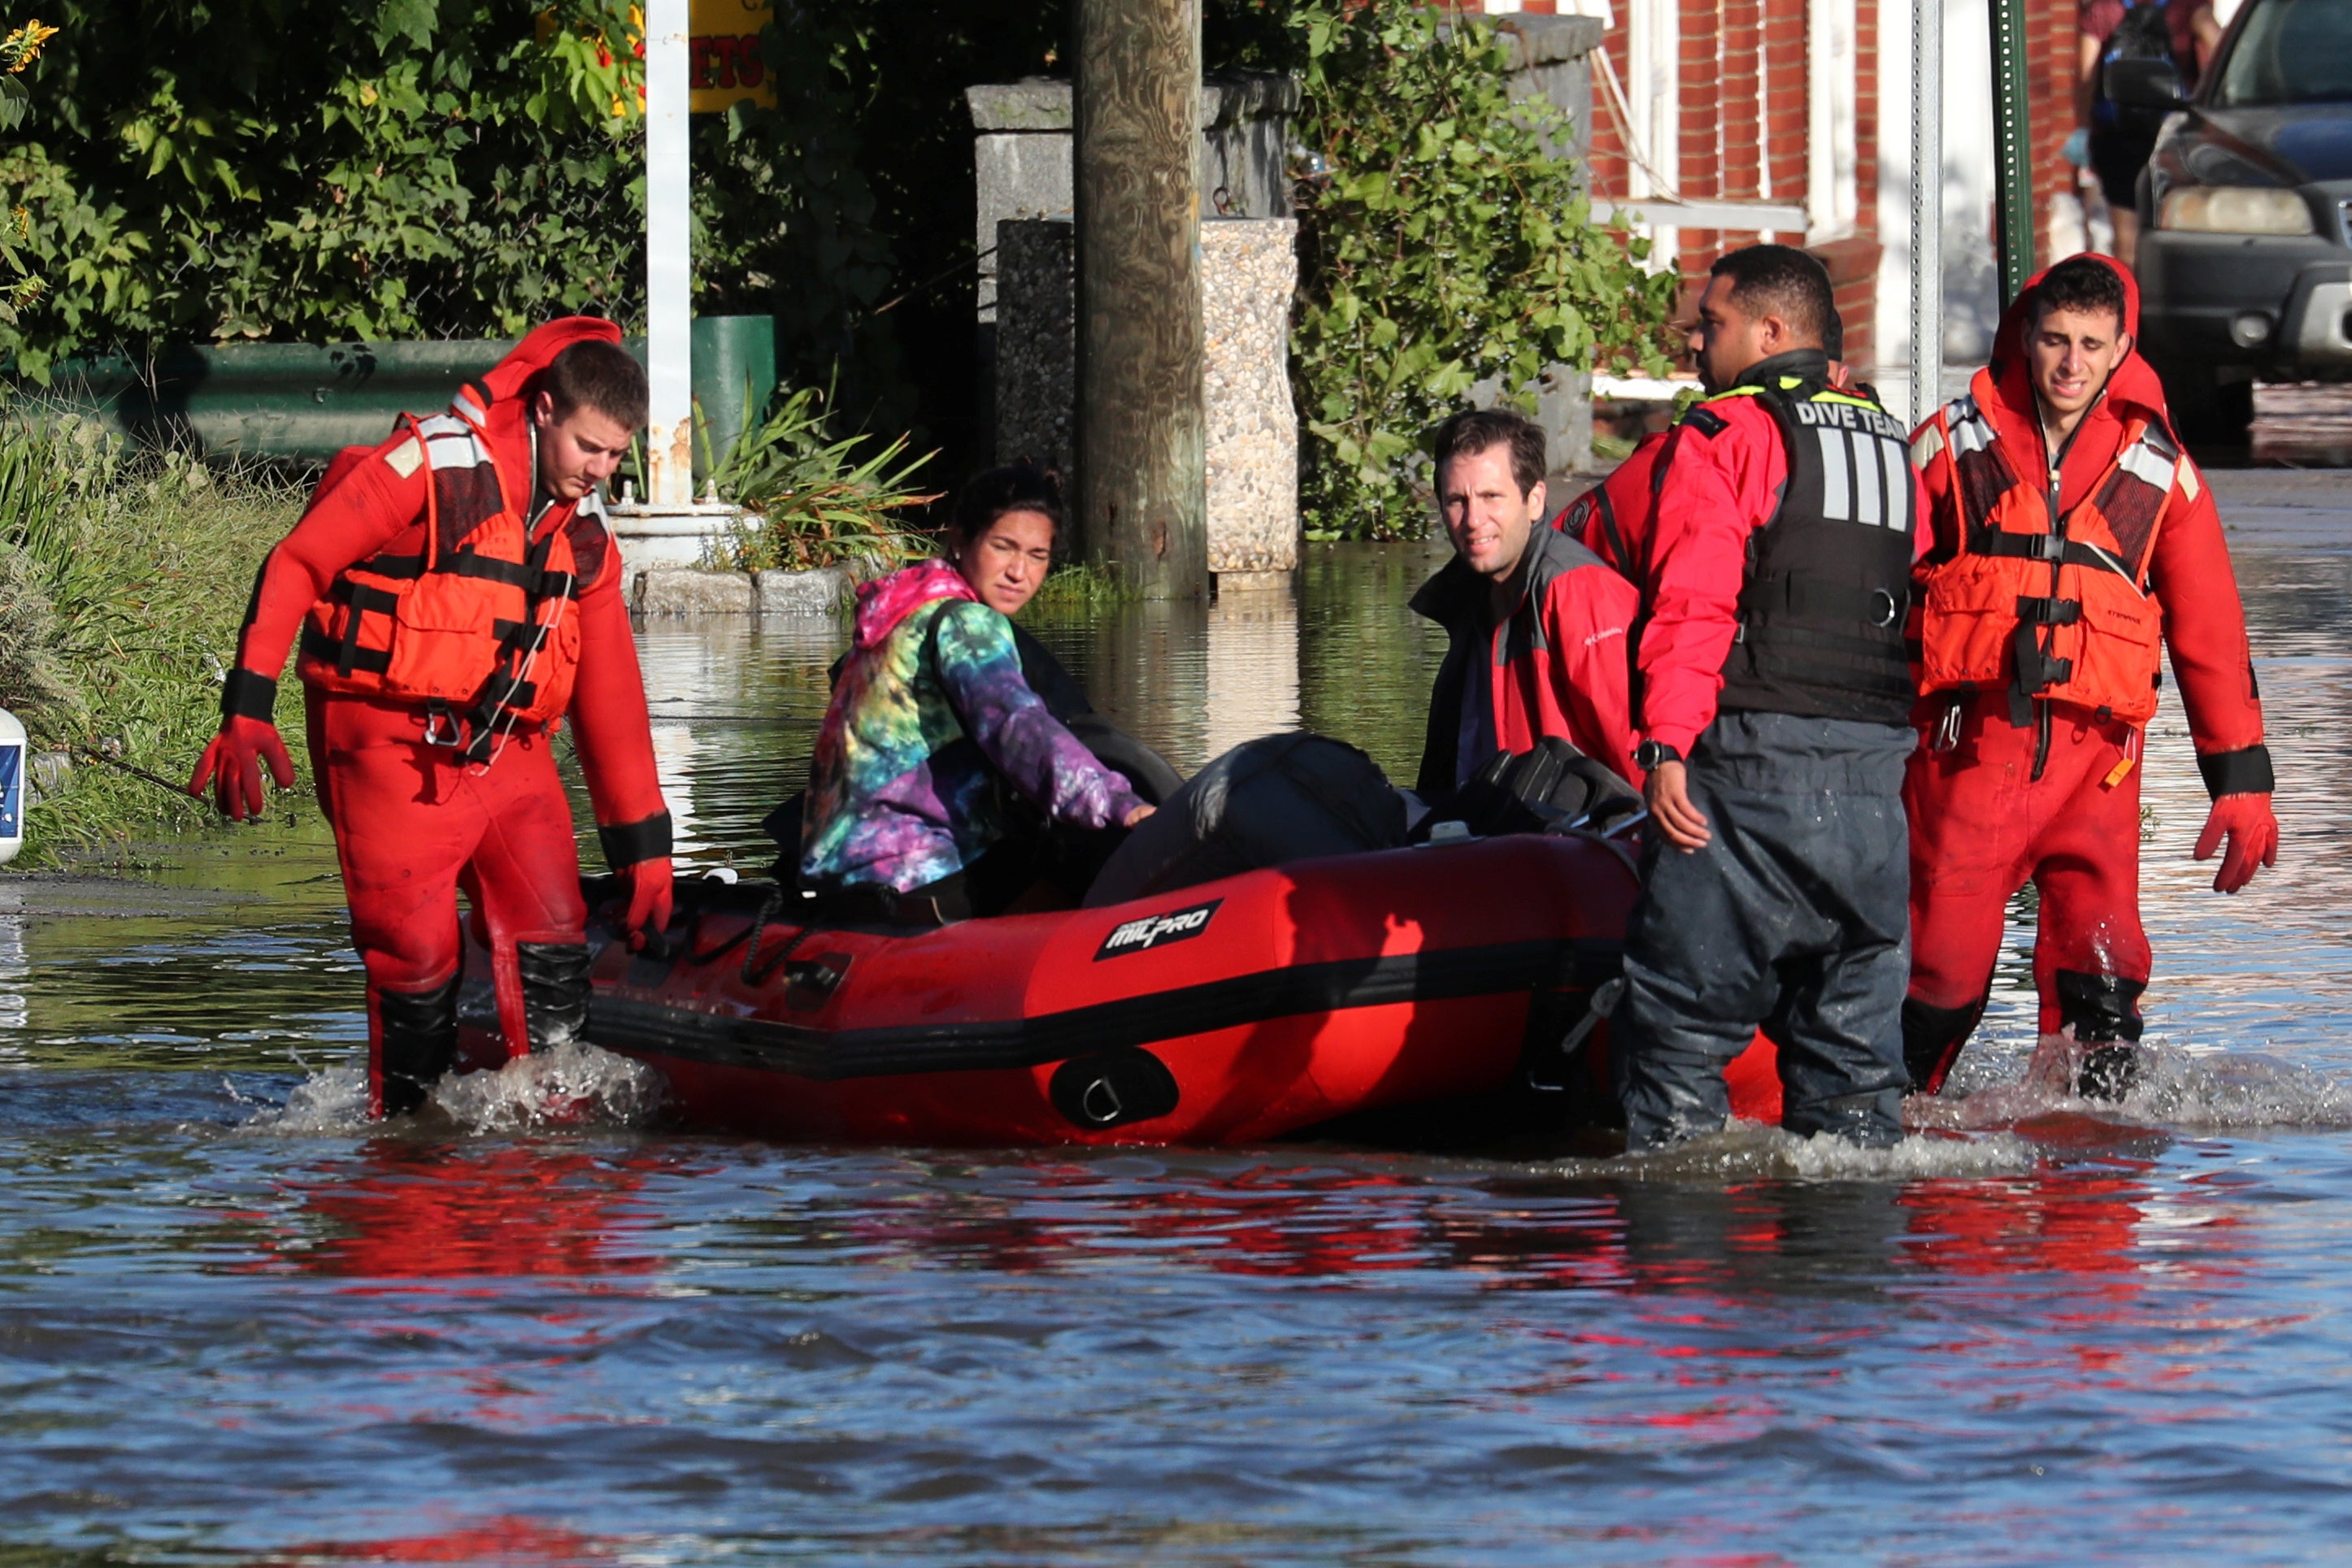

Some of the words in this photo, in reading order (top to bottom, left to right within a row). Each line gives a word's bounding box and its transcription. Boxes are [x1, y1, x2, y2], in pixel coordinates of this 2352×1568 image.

[689, 34, 764, 89] ETS
[1795, 402, 1857, 428] DIVE
[1857, 408, 1909, 444] TEAM
